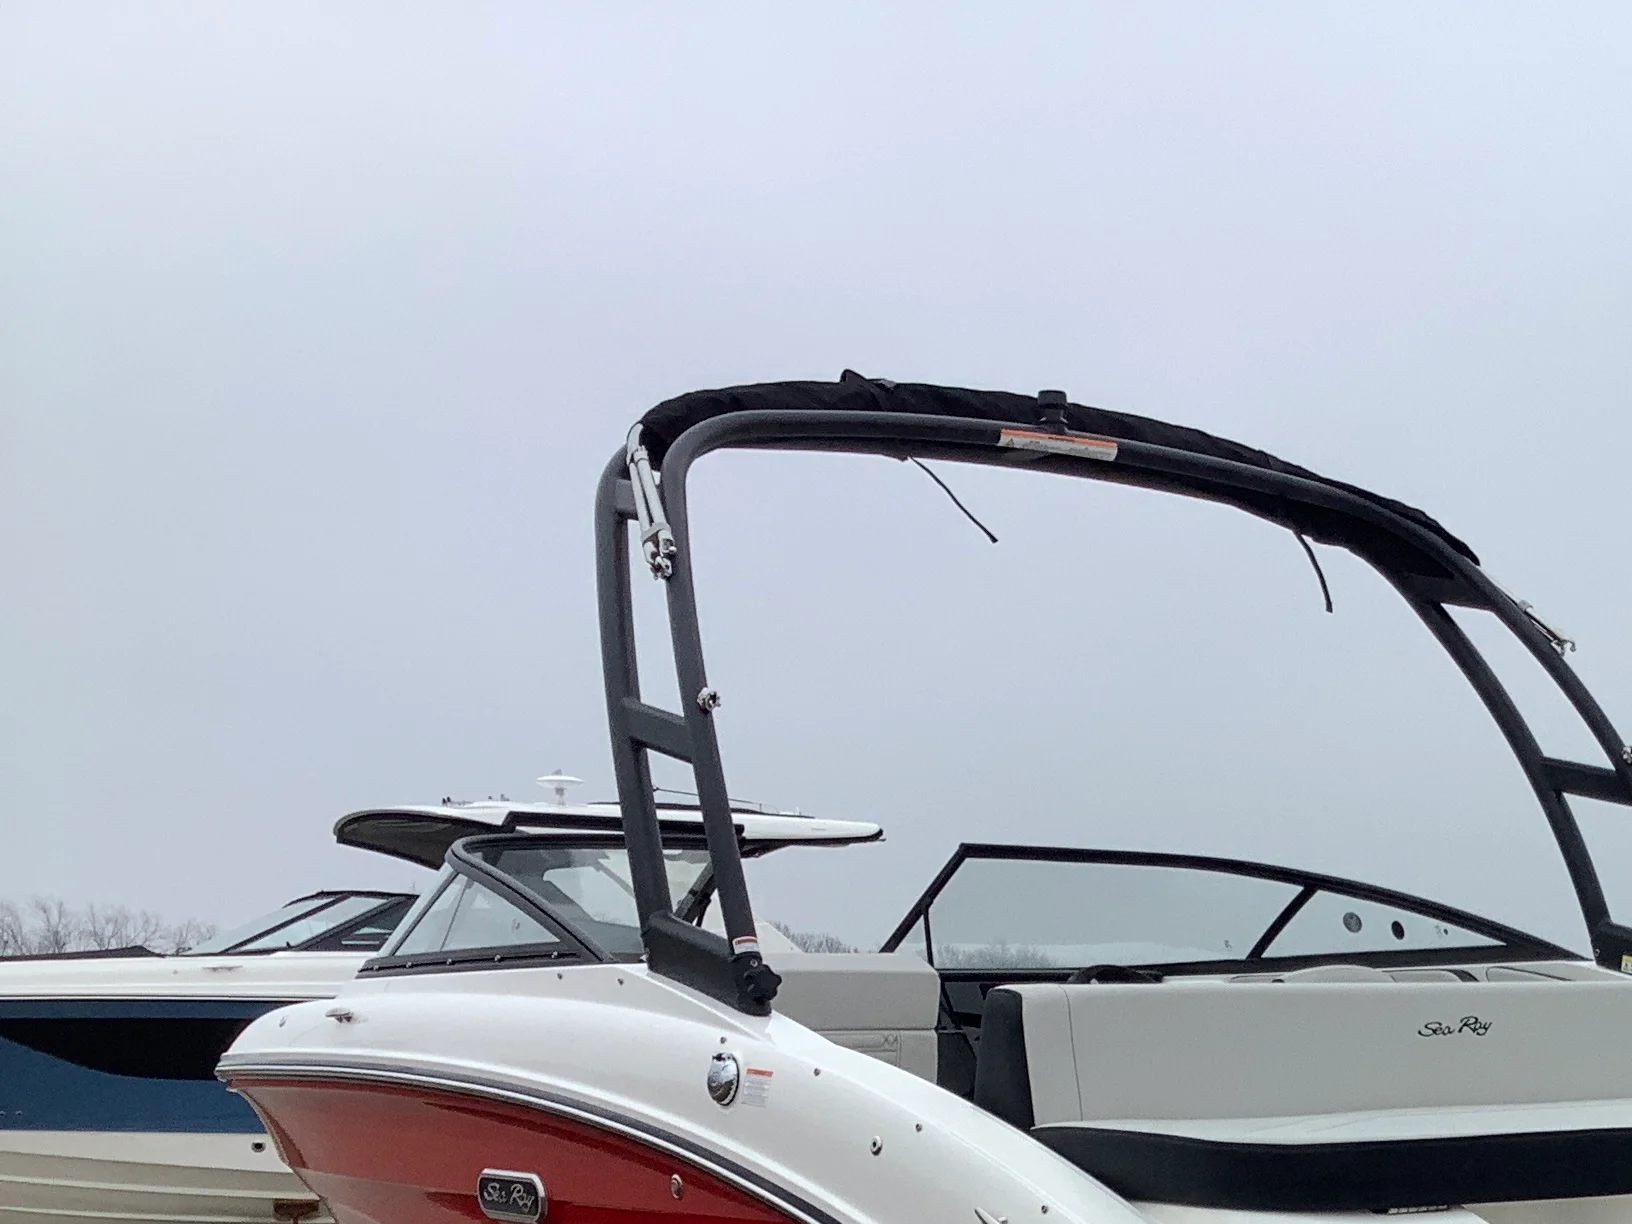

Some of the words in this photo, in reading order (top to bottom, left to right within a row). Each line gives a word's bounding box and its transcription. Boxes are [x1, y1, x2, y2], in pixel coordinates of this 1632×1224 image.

[1417, 1021, 1456, 1037] Sea
[1457, 1015, 1493, 1036] Ray
[483, 1182, 508, 1203] Sea
[509, 1183, 536, 1213] Ray
